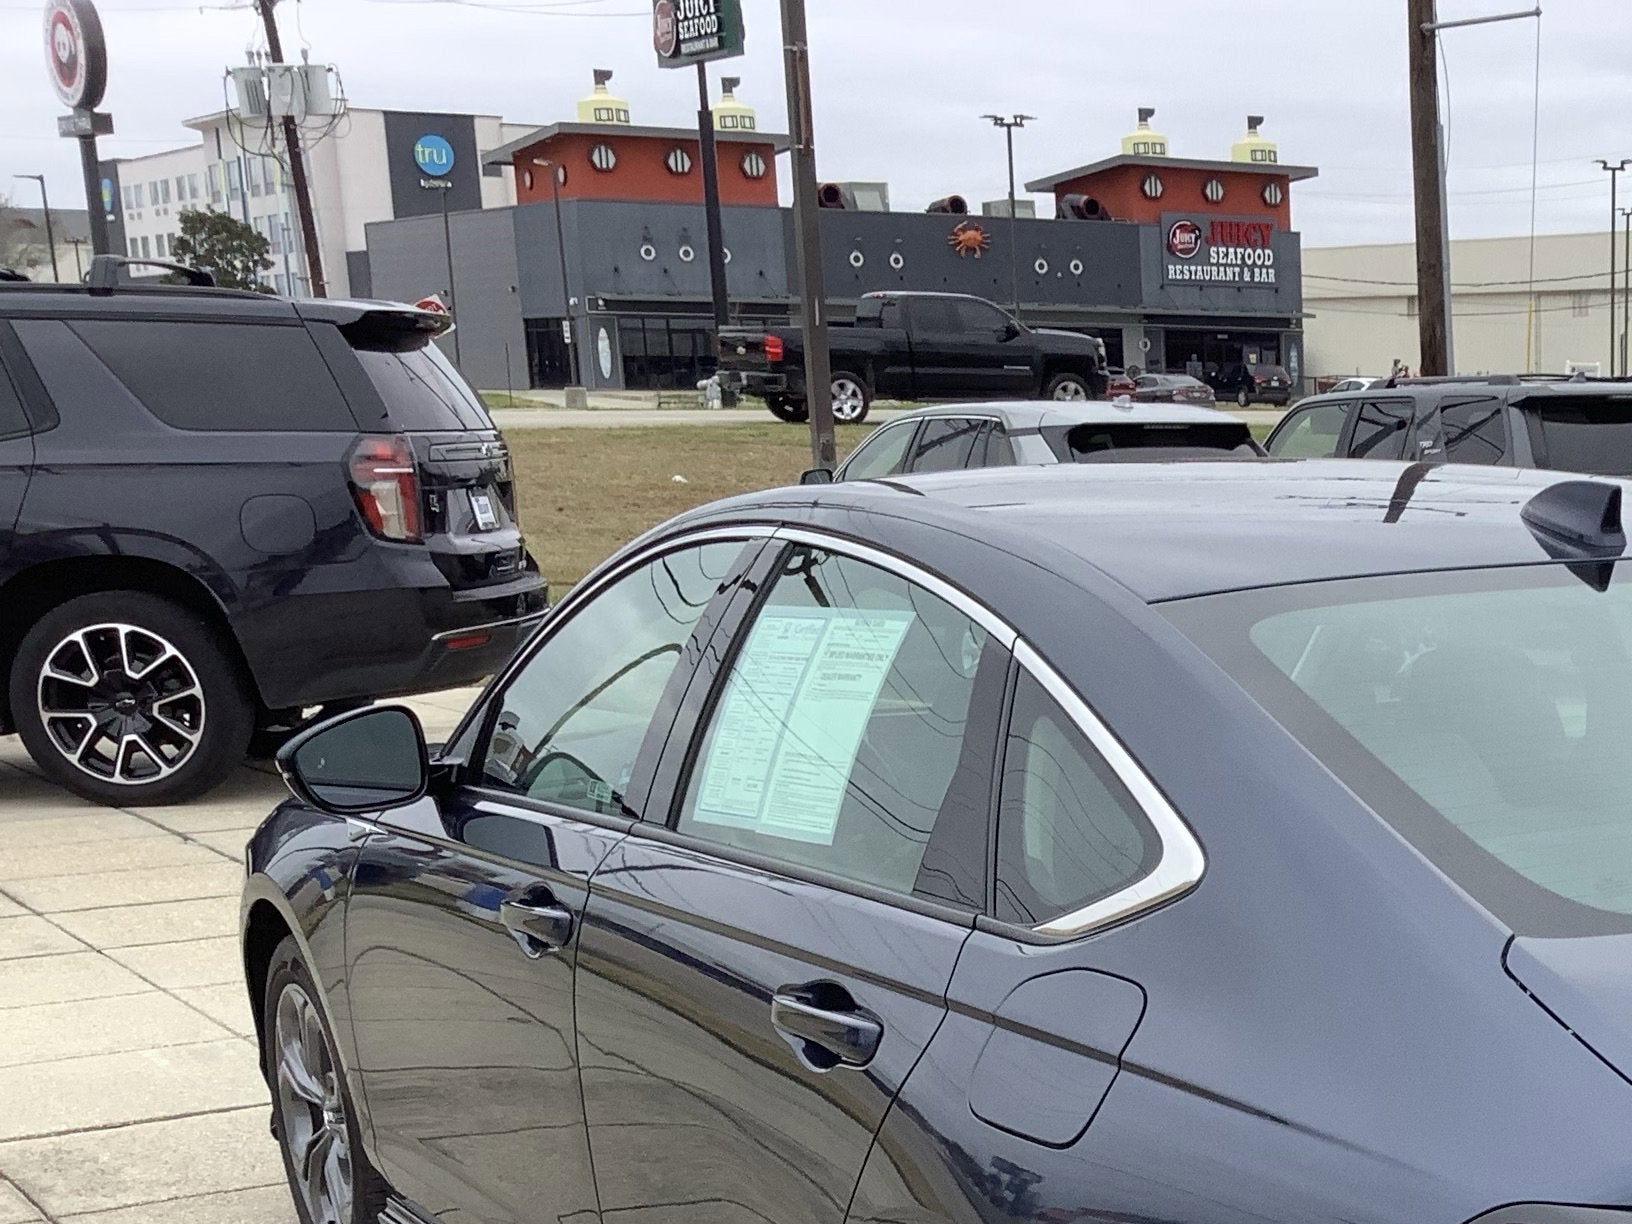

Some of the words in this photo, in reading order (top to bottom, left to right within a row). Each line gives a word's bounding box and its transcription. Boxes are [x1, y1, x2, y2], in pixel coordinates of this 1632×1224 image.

[678, 14, 718, 40] SEAFOOD
[415, 143, 447, 165] tru
[1205, 221, 1273, 248] JUICY
[1209, 246, 1274, 266] SEAFOOD
[1168, 264, 1240, 281] RESTAURANT
[1243, 267, 1251, 282] &
[1254, 267, 1276, 282] BAR
